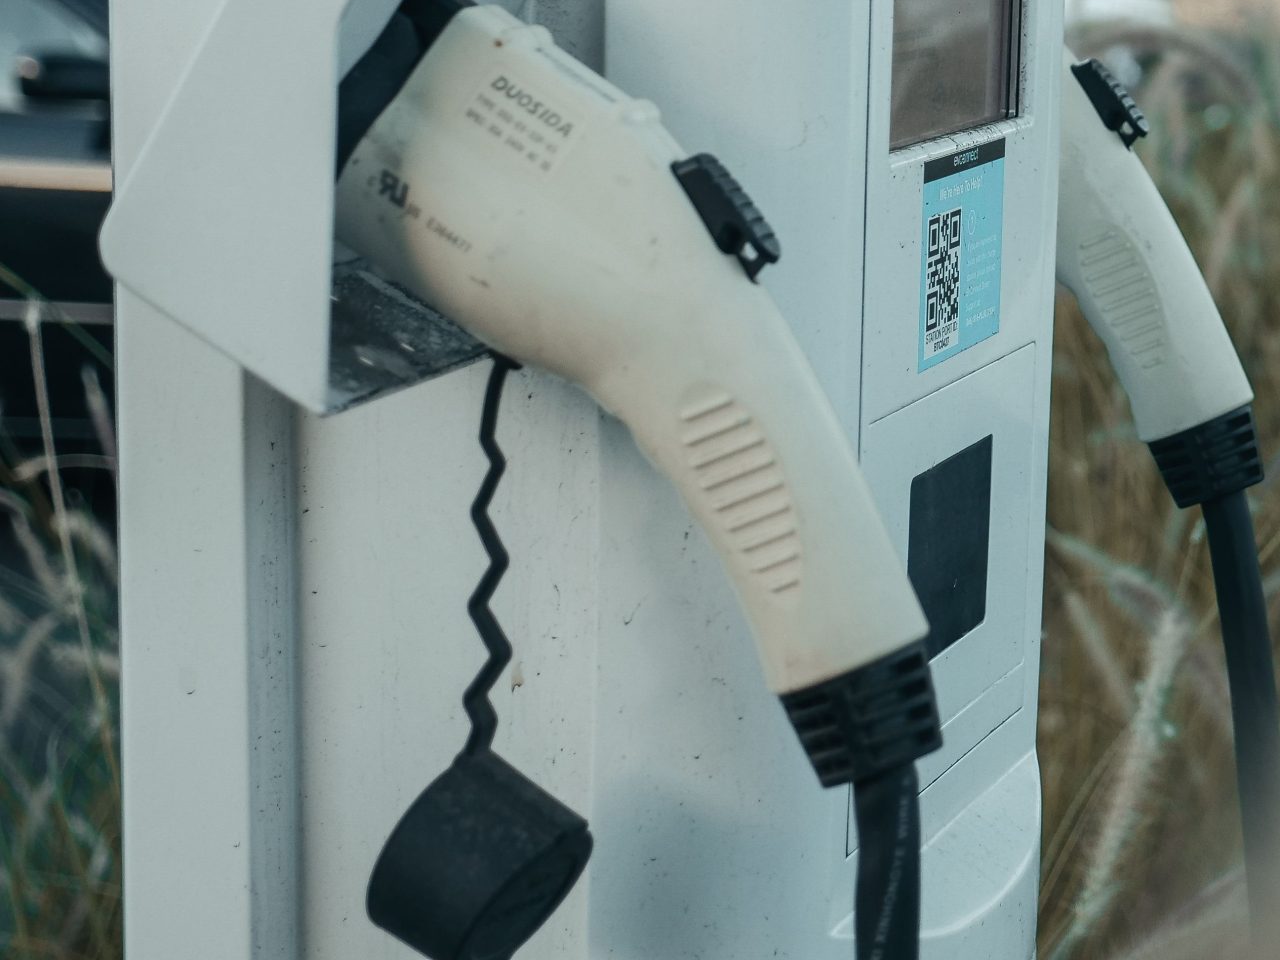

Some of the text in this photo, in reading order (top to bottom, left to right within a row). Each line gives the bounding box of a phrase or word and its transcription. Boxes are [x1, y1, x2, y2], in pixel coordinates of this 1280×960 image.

[491, 76, 574, 137] DUOSIDA
[926, 328, 942, 345] STATION
[942, 322, 953, 339] PORT
